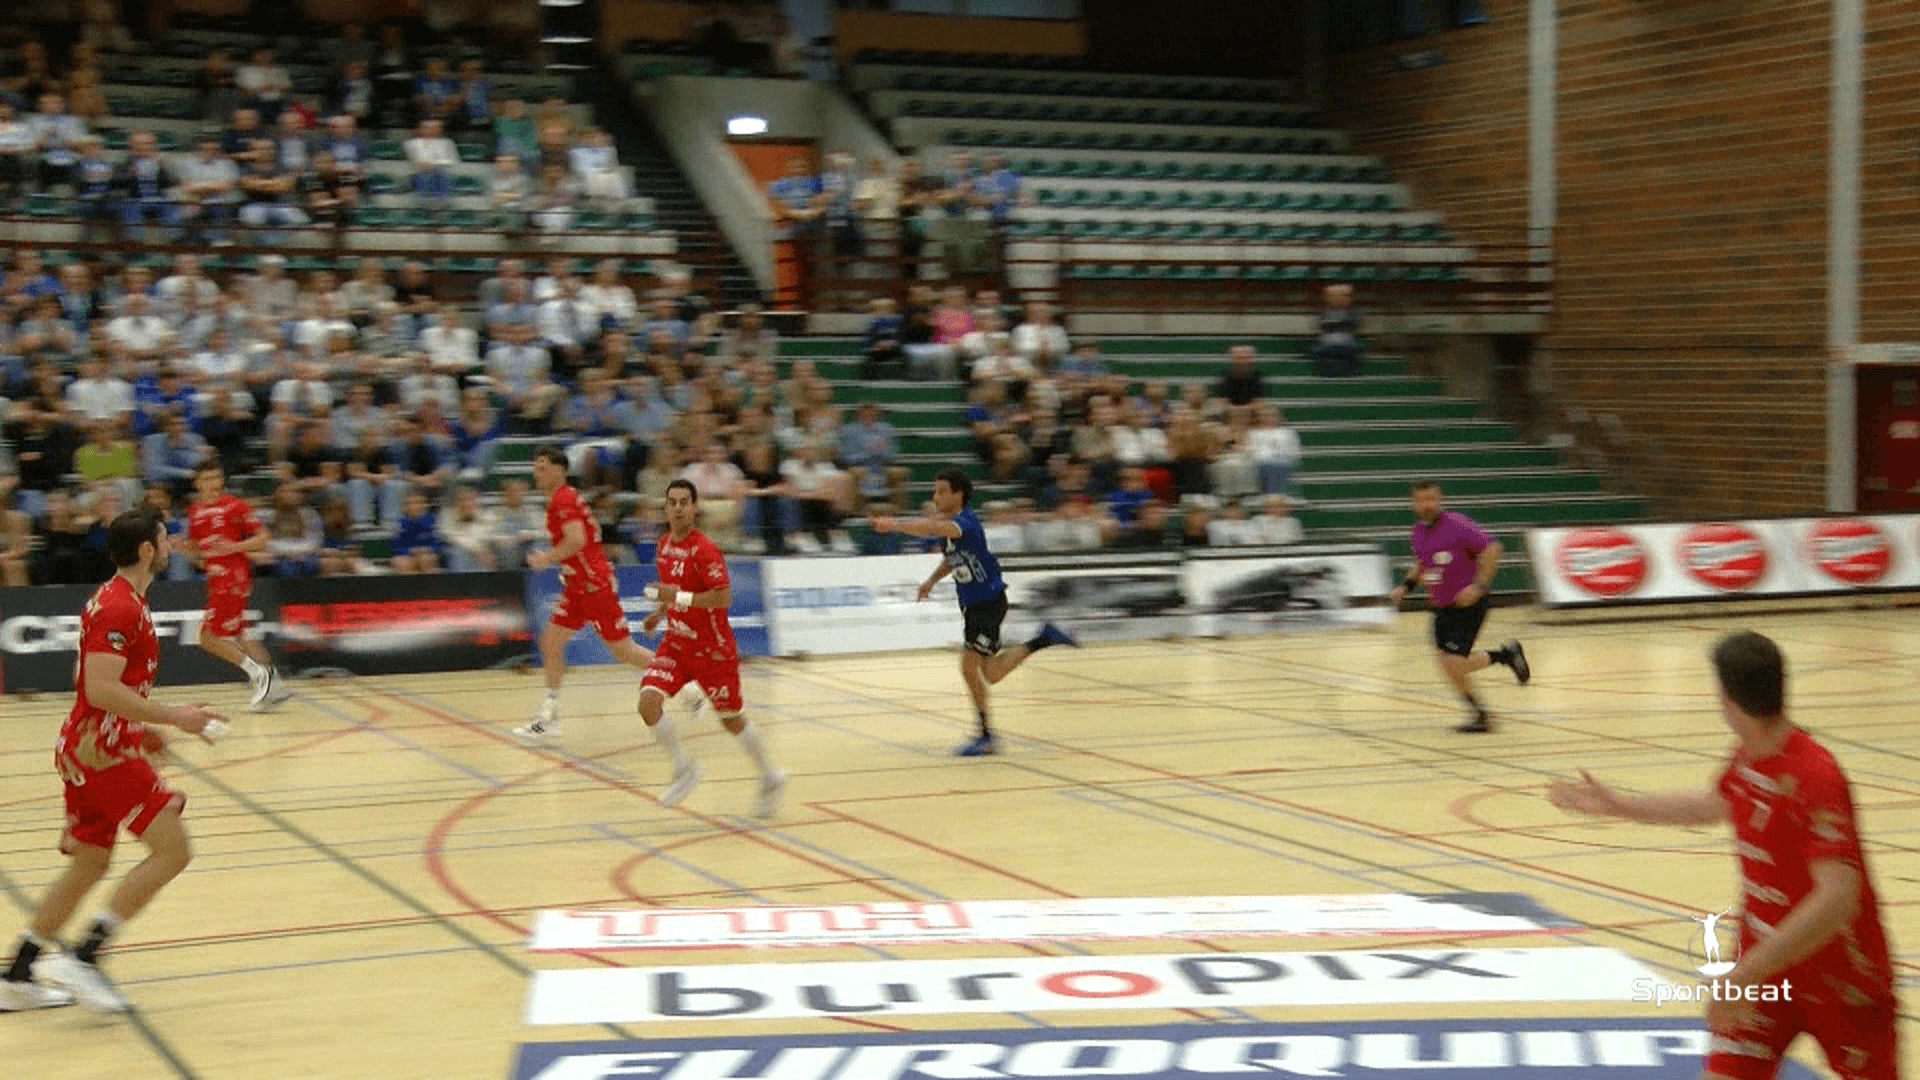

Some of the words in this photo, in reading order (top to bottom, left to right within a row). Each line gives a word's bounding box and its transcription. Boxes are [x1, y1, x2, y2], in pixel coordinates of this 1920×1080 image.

[670, 560, 685, 577] 24
[707, 685, 730, 698] 24
[650, 952, 1518, 1018] buropix
